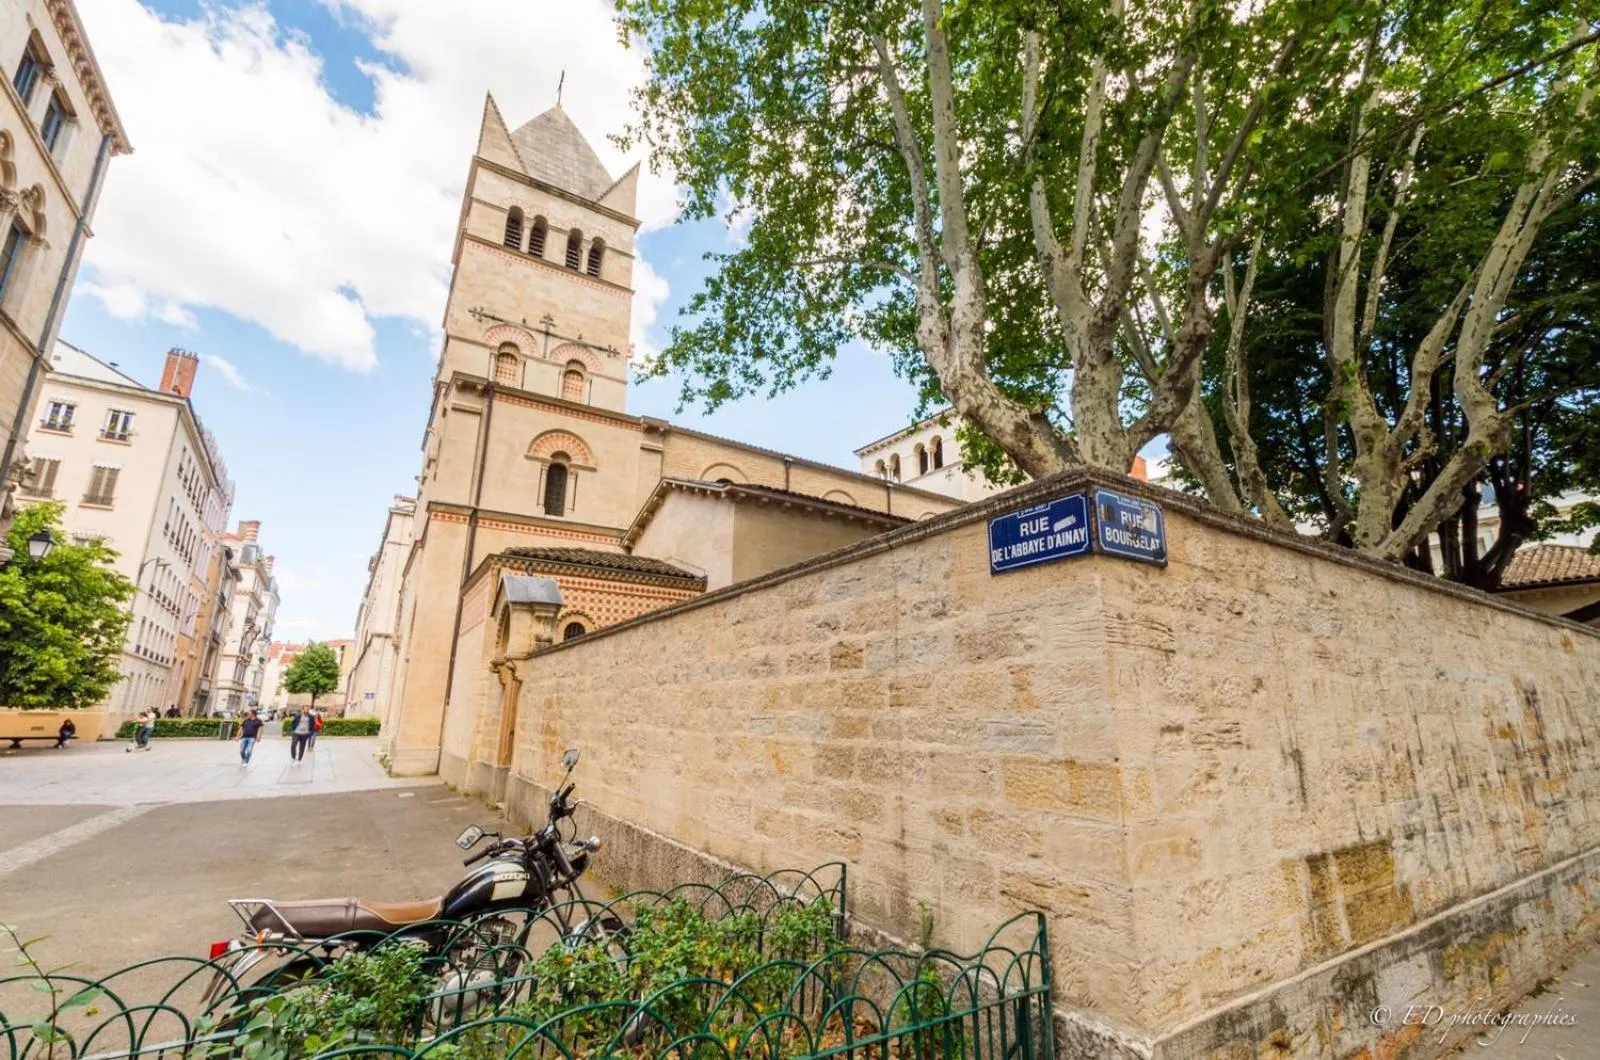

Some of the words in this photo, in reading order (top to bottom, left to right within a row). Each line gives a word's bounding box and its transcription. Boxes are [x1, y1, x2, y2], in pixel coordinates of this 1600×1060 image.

[1020, 516, 1049, 537] RUE
[1120, 511, 1144, 530] RUE
[992, 547, 1004, 563] DE
[1004, 537, 1045, 560] L'ABBAYE
[1047, 527, 1086, 550] D'AINAY
